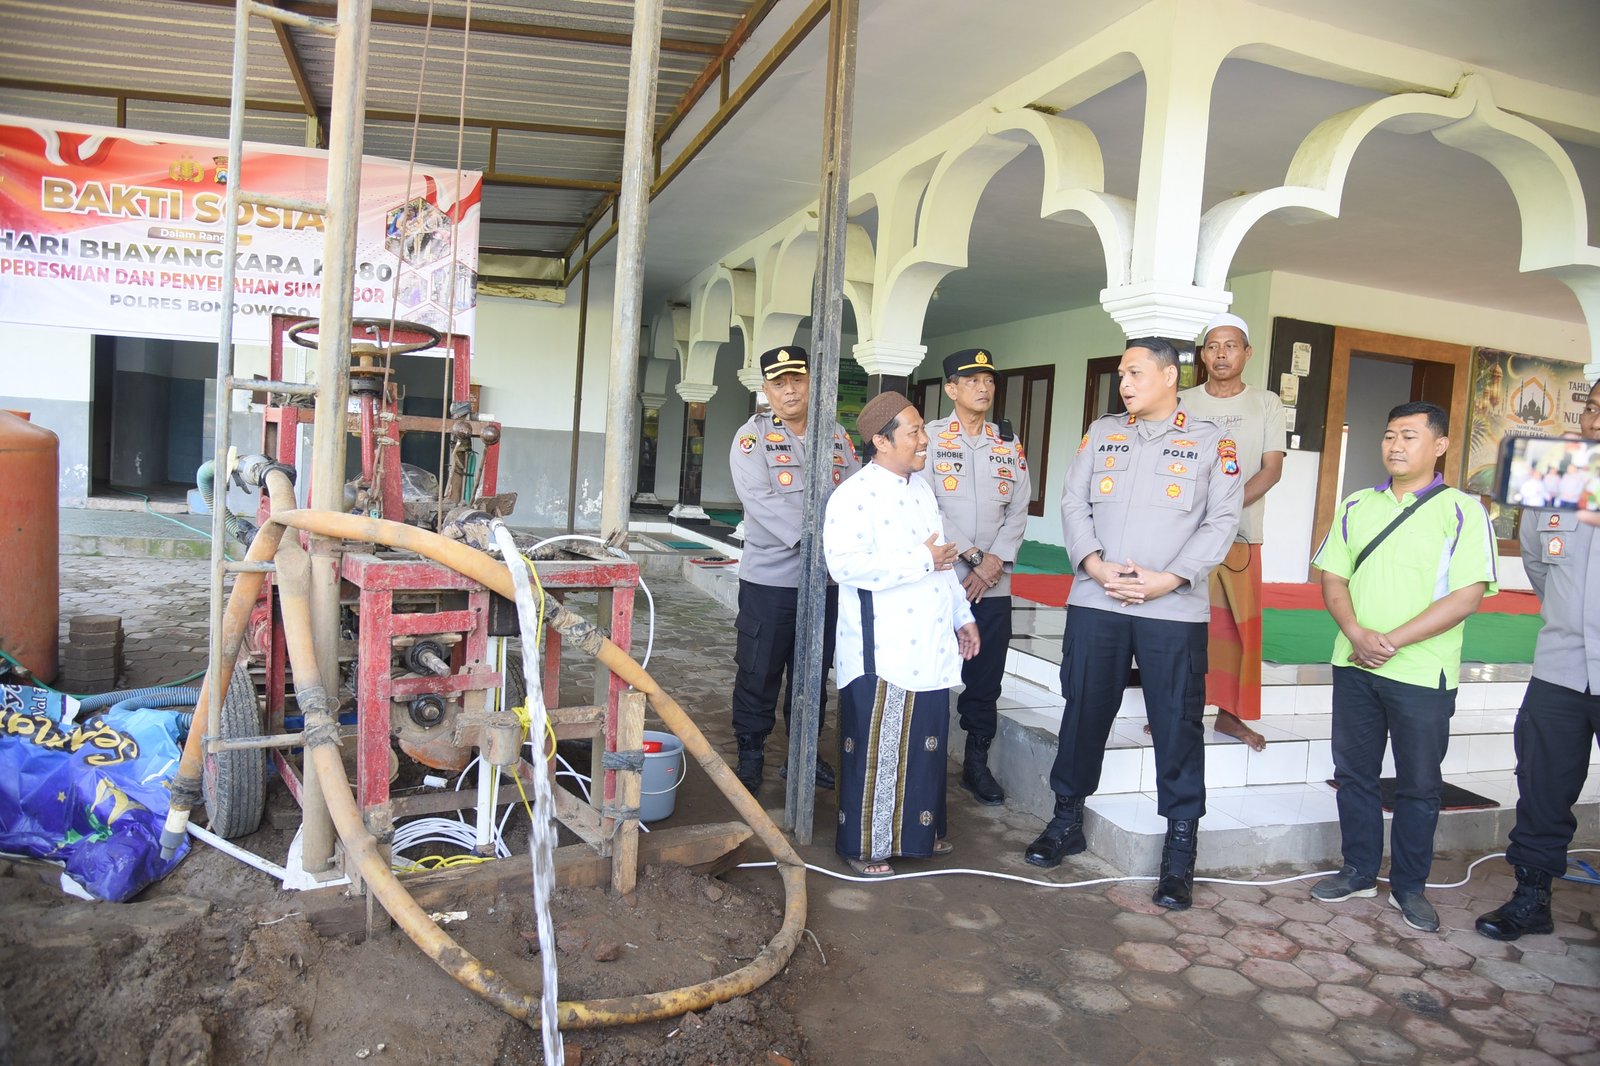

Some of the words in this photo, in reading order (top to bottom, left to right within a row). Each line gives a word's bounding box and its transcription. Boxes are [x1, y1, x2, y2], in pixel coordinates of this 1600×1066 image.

[42, 176, 183, 222] BAKTI
[194, 191, 326, 233] SOSIA
[160, 228, 196, 239] Dalam
[1, 258, 109, 283] PERESMIAN
[115, 268, 154, 287] DAN
[110, 294, 182, 311] POLRES
[1098, 444, 1130, 453] ARYO
[1163, 448, 1198, 460] POLRI
[936, 450, 963, 459] SHOBIE
[989, 455, 1015, 465] POLRI
